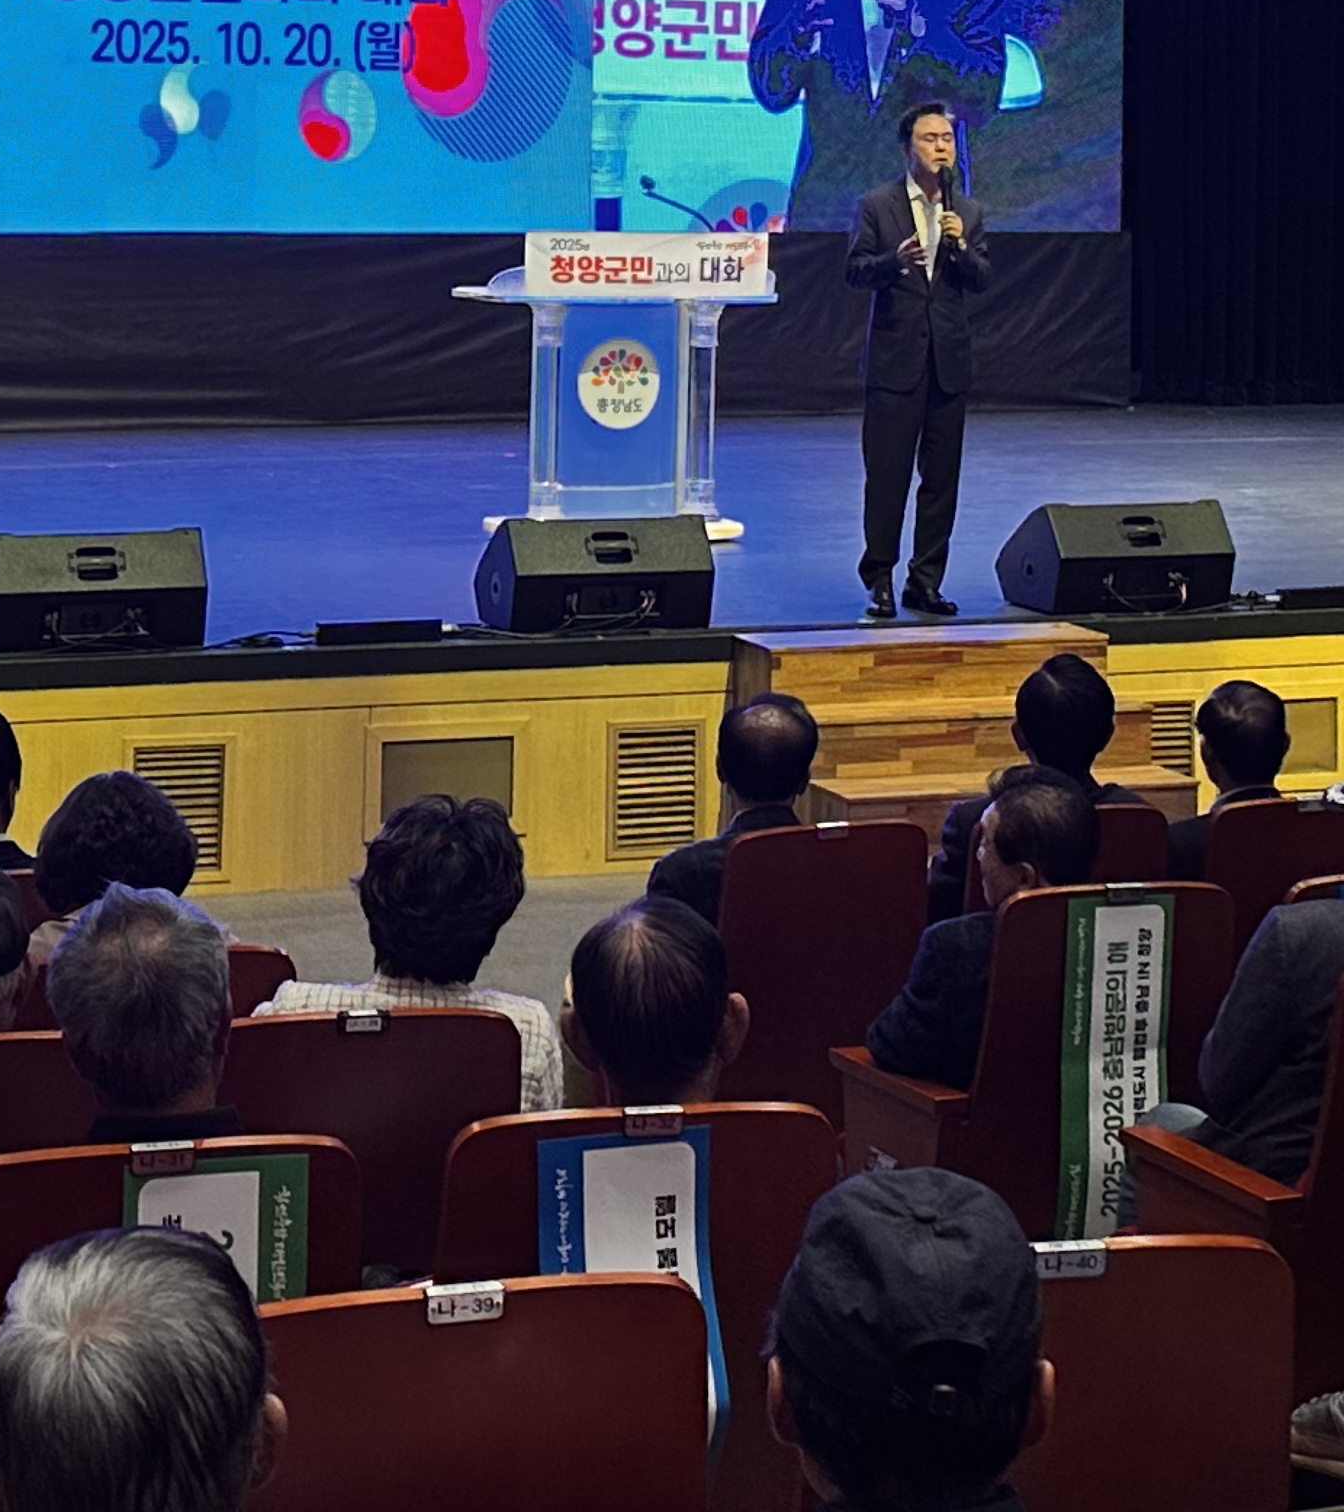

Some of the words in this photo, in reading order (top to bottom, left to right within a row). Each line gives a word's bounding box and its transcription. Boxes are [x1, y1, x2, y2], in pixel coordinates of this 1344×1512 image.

[91, 19, 200, 66] 2025.
[217, 21, 270, 67] 10.
[284, 22, 341, 69] 20.
[353, 22, 415, 73] (월)
[550, 255, 691, 284] 청양군민과의
[699, 256, 745, 284] 대화
[597, 398, 643, 413] 충청남도
[1107, 941, 1130, 964] 해
[1136, 961, 1150, 981] IN
[1102, 970, 1128, 1080] 충남방문의
[1101, 1086, 1127, 1217] 2025-2026
[437, 1297, 496, 1319] 나-39
